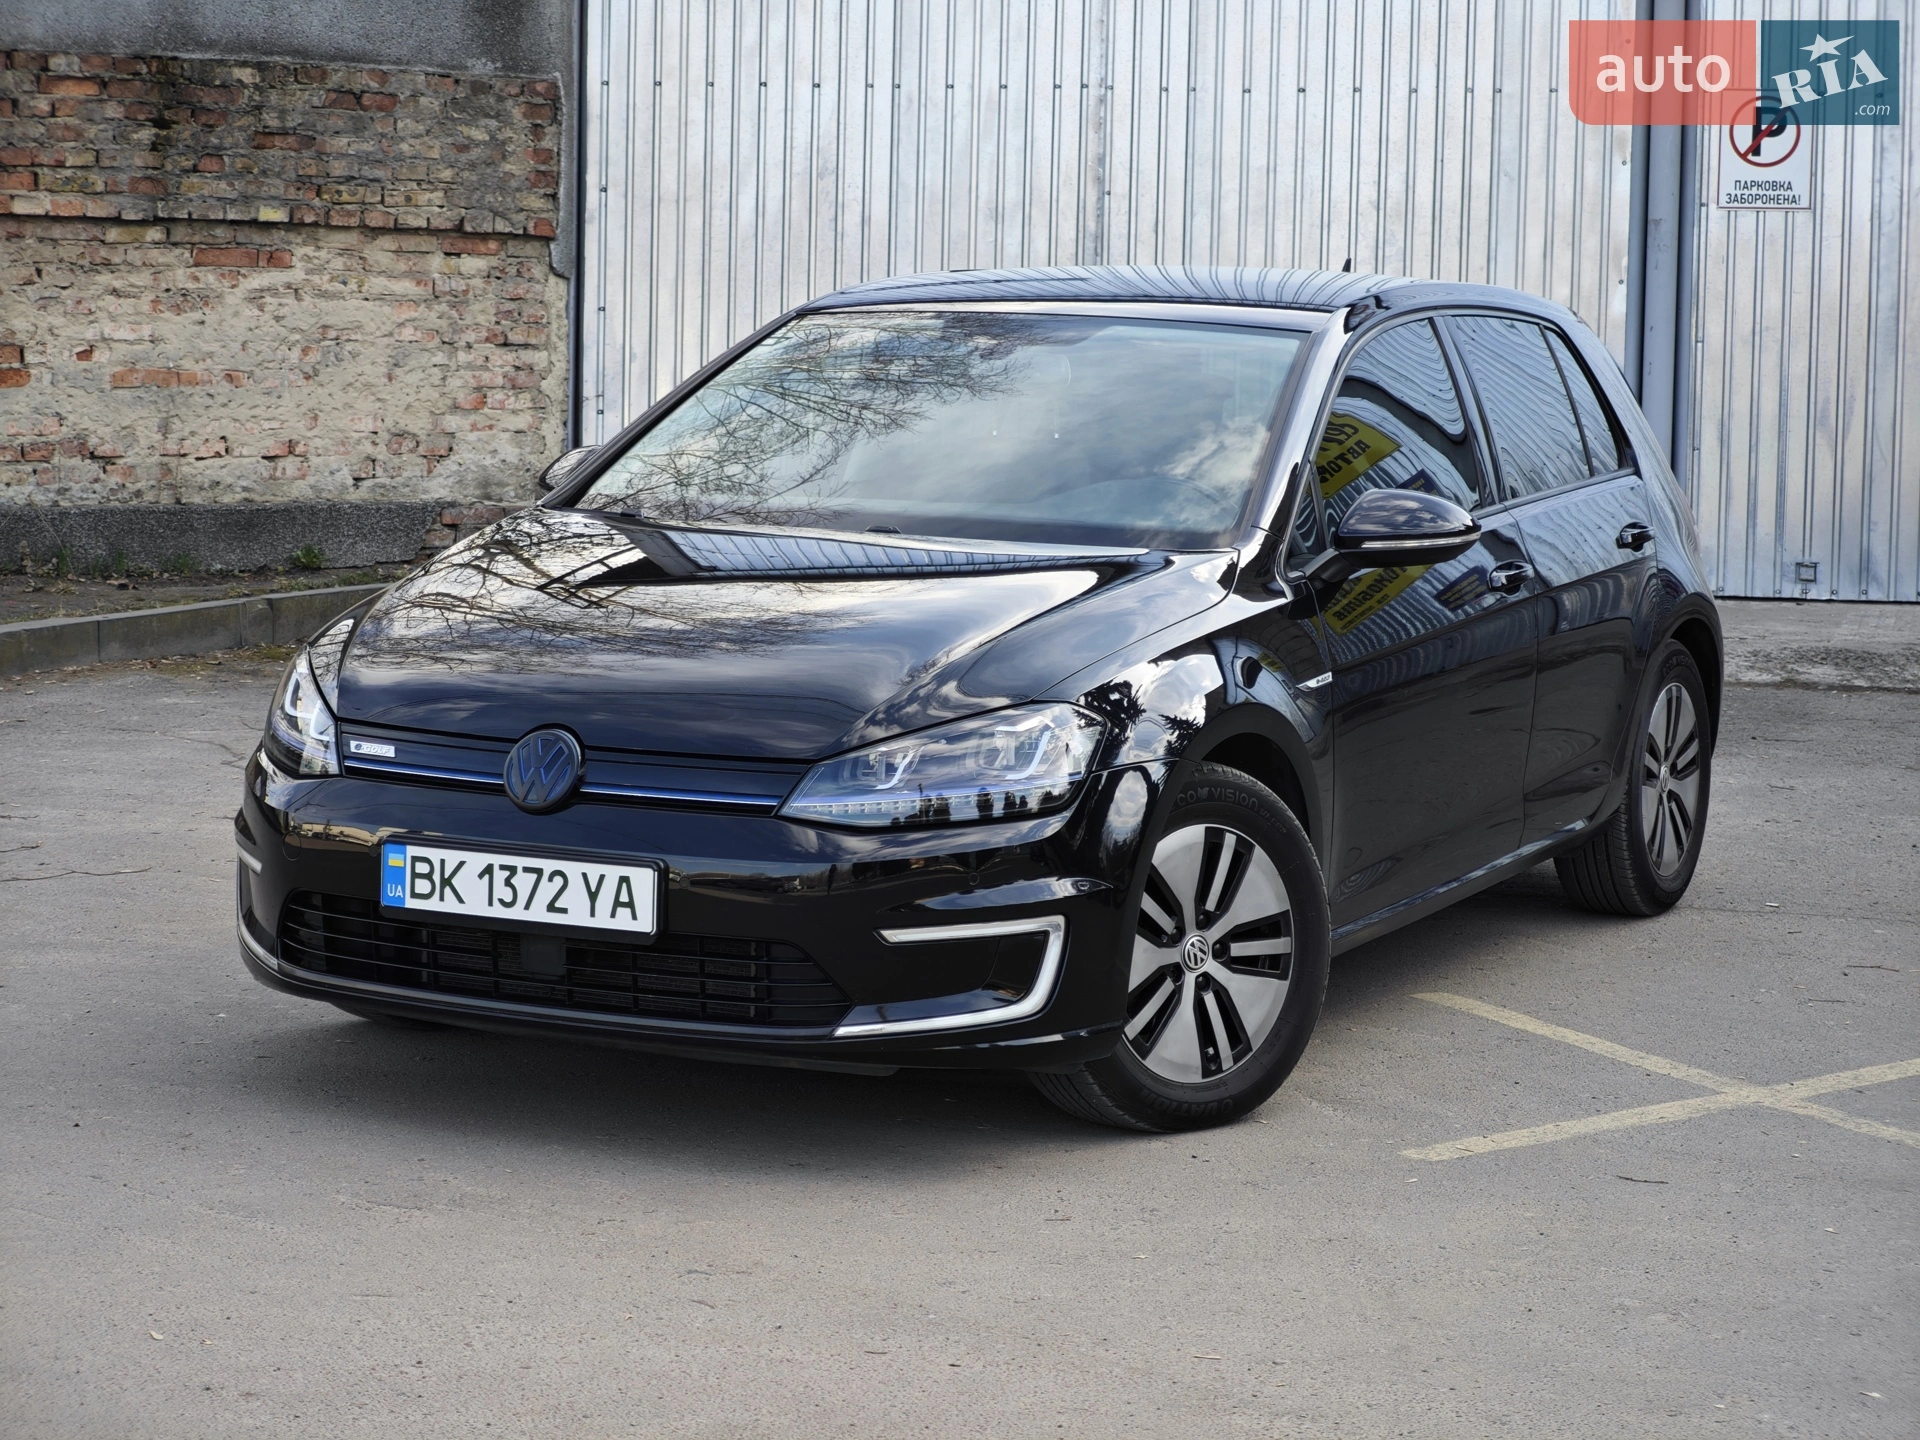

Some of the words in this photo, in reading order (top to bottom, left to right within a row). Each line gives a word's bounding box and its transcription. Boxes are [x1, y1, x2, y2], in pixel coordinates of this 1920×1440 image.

[1734, 180, 1793, 192] ПАРКОВКА
[1725, 193, 1801, 205] ЗАБОРОНЕНА!
[387, 883, 404, 898] UA
[410, 855, 467, 905] BK
[477, 862, 569, 915] 1372
[581, 872, 638, 921] YA
